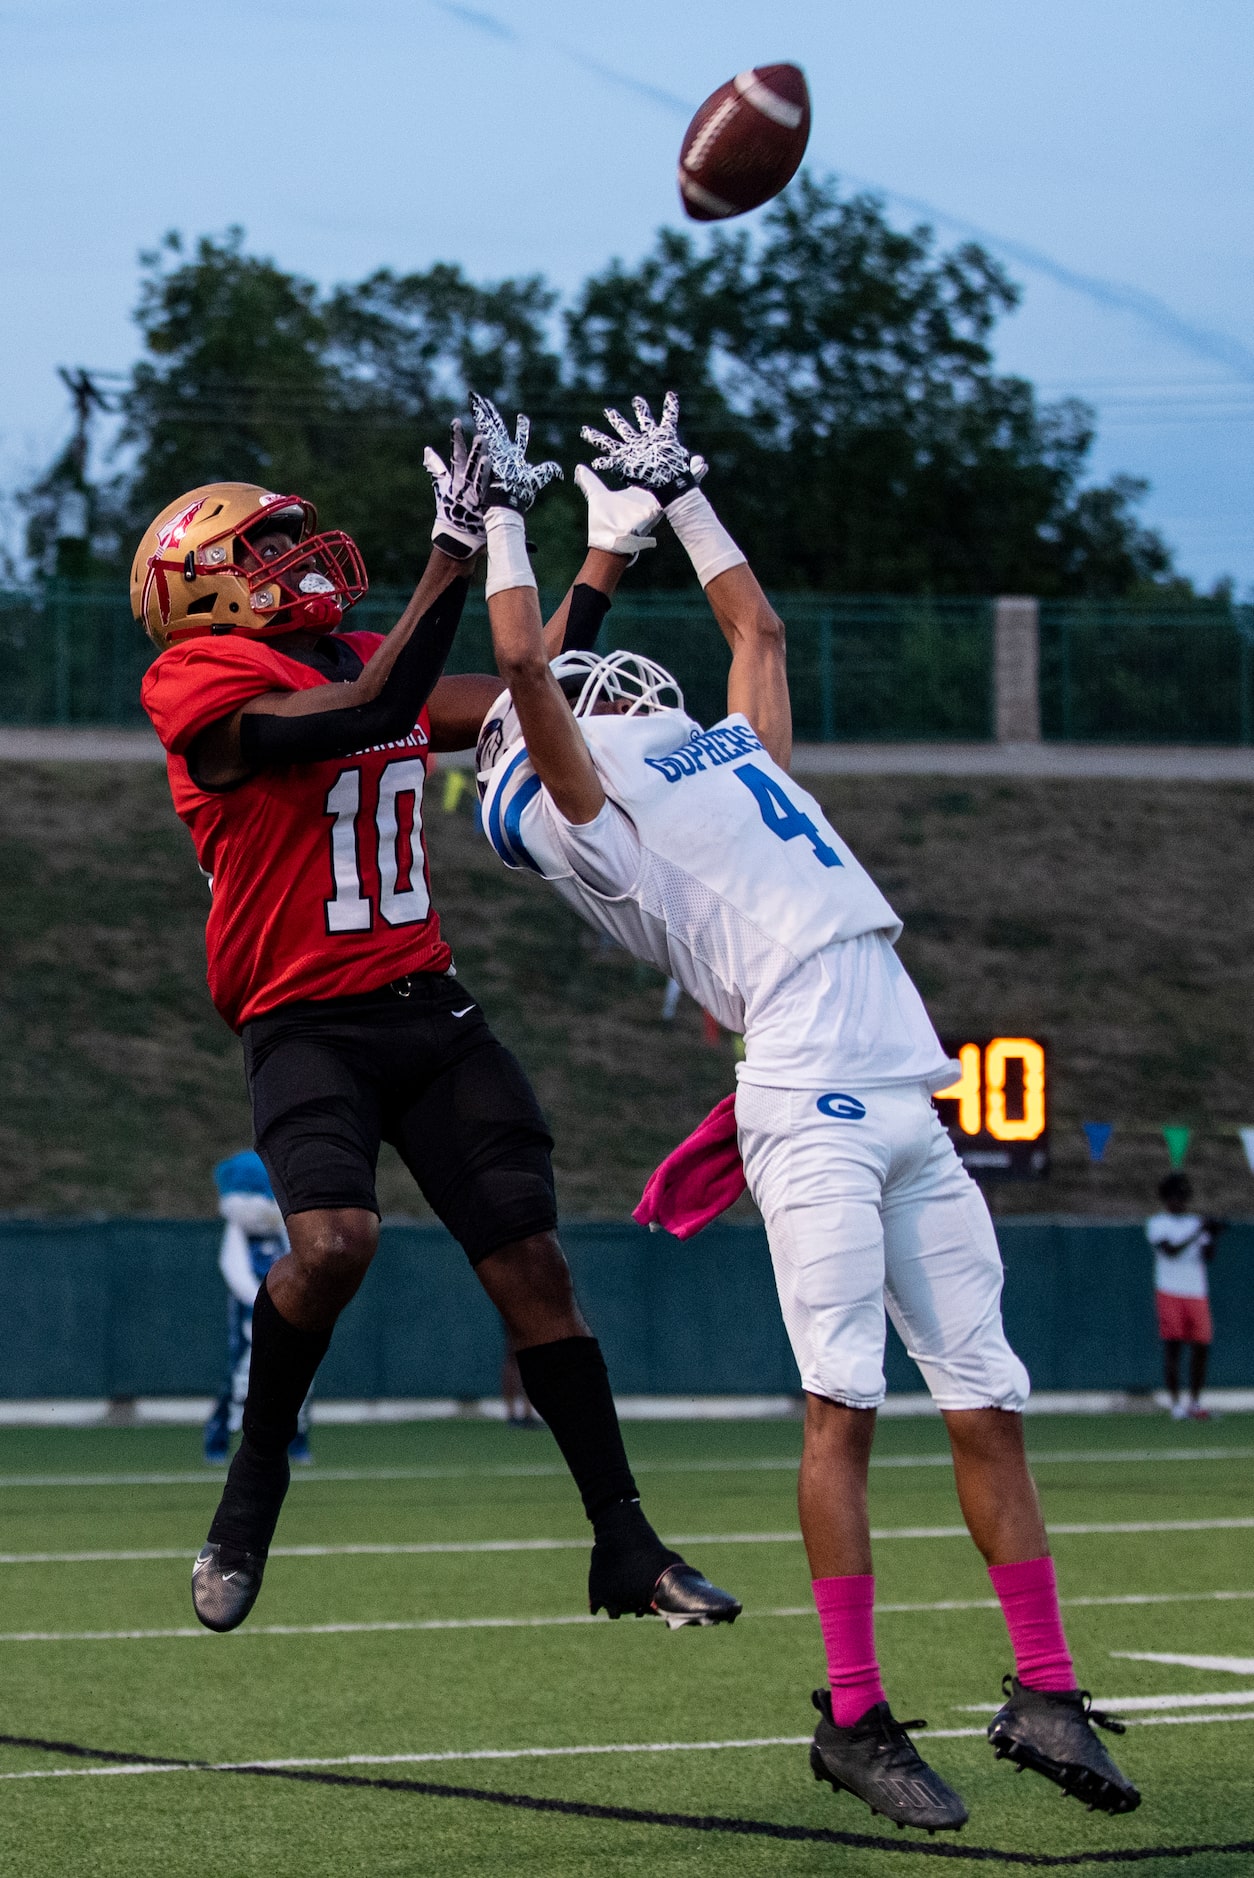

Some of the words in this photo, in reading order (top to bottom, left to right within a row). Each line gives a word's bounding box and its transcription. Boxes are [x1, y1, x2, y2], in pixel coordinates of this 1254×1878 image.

[324, 757, 431, 935] 10
[733, 762, 845, 869] 4
[816, 1092, 867, 1121] G
[931, 1037, 1046, 1142] 40
